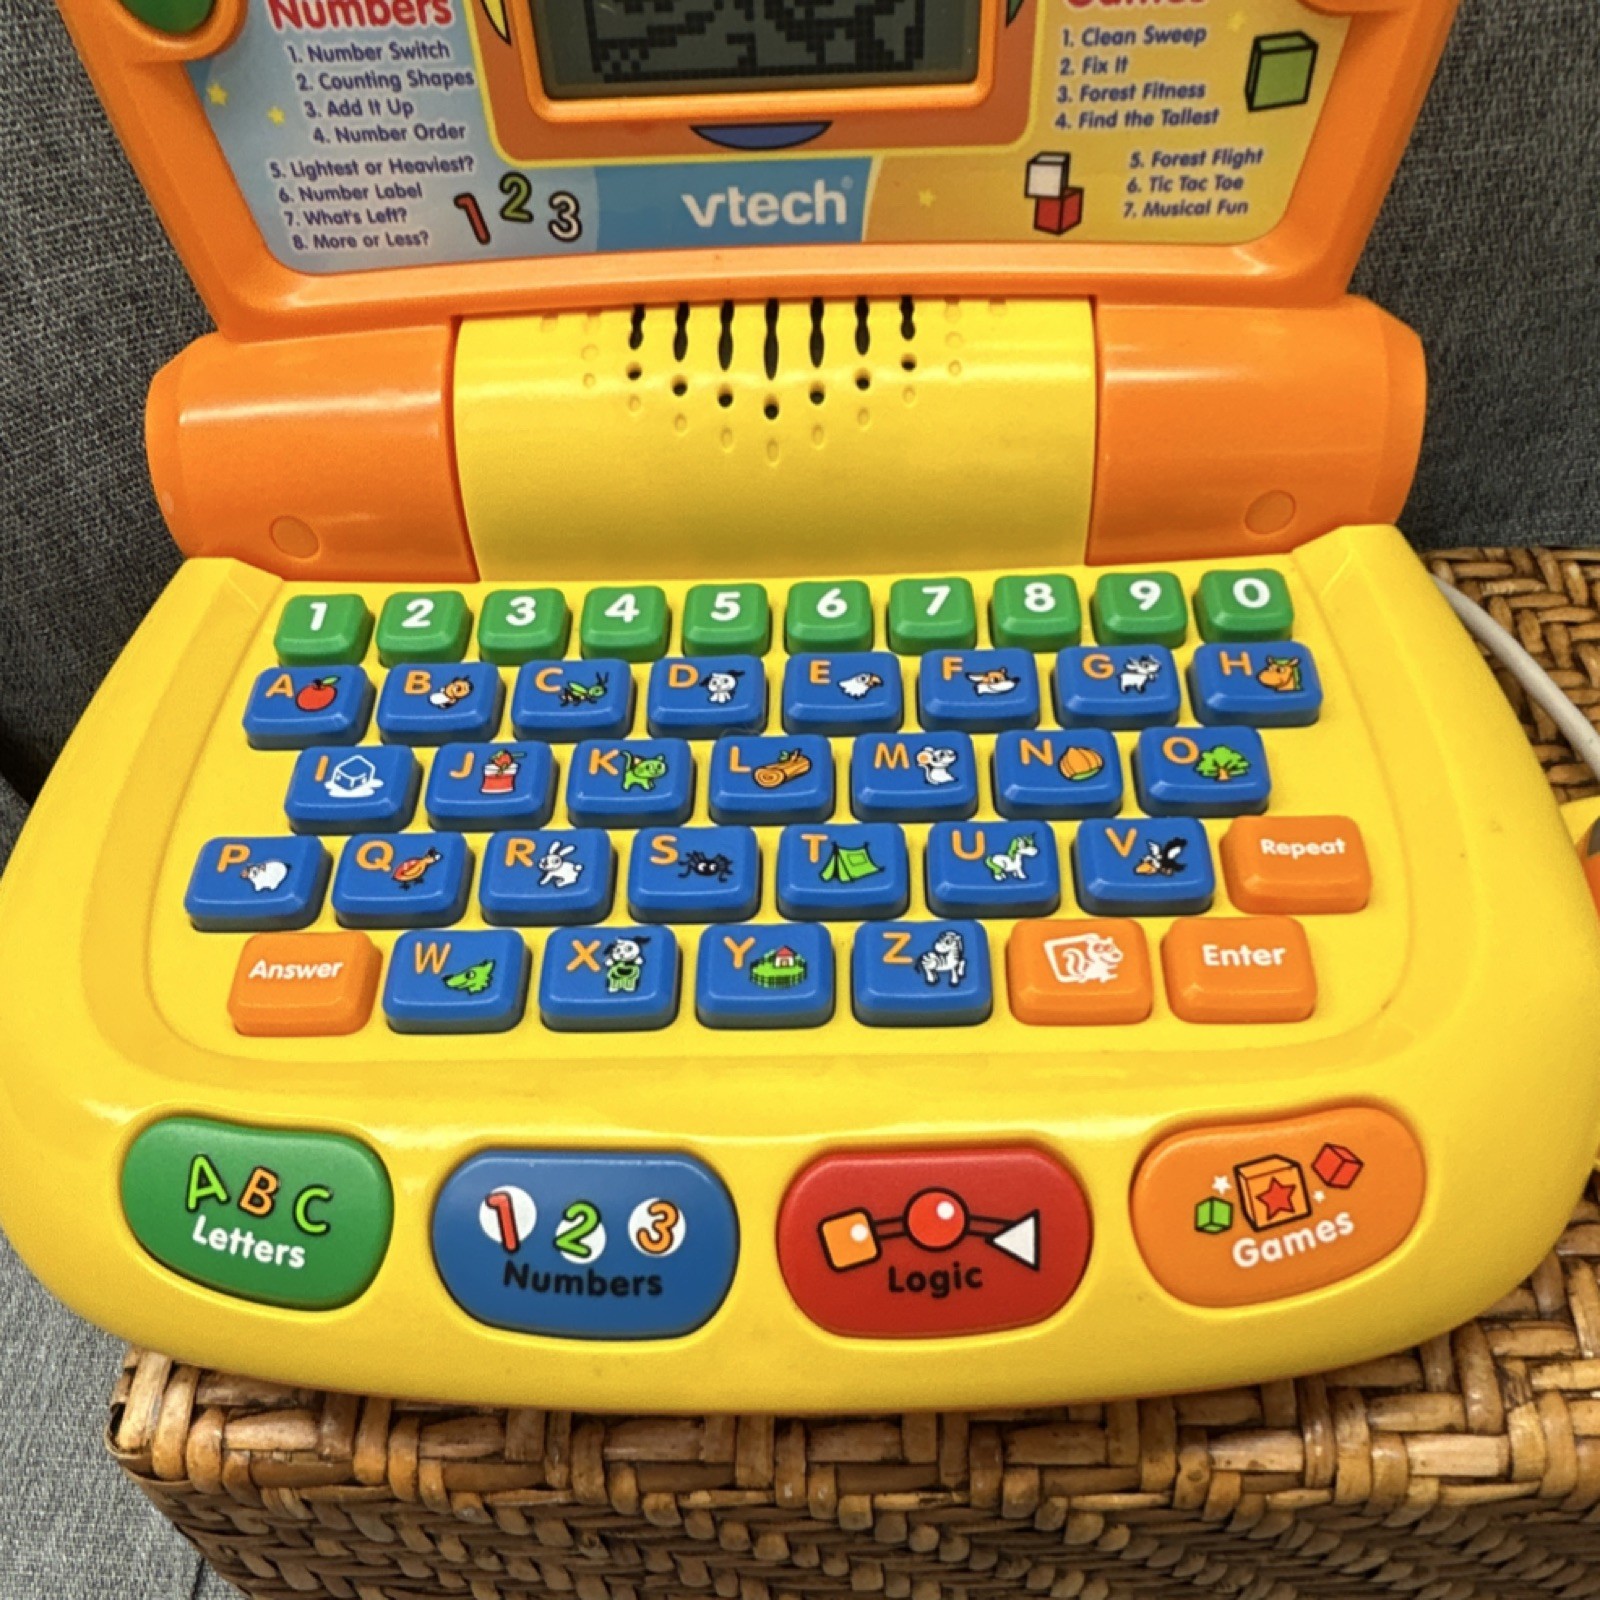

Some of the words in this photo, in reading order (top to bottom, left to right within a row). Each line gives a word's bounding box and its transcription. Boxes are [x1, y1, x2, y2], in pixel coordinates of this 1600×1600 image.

[268, 0, 453, 29] Numbers
[1063, 28, 1074, 47] 1.
[1082, 27, 1136, 47] Clean
[1144, 25, 1207, 46] Sweep
[288, 45, 302, 63] 1.
[307, 44, 383, 62] Number
[389, 41, 450, 59] Switch
[1060, 57, 1074, 76] 2.
[1082, 56, 1108, 74] Fix
[1115, 56, 1128, 73] It
[297, 74, 313, 91] 2.
[319, 71, 402, 92] Counting
[407, 69, 474, 91] Shapes
[1057, 86, 1072, 103] 3.
[1080, 84, 1136, 102] Forest
[1143, 82, 1206, 99] Fitness
[304, 101, 321, 118] 3.
[327, 99, 363, 117] Add
[369, 99, 381, 115] It
[388, 99, 414, 119] Up
[1056, 112, 1071, 129] 4.
[1079, 111, 1118, 129] Find
[1124, 109, 1154, 127] the
[1161, 108, 1219, 126] Tallest
[313, 128, 331, 143] 4.
[334, 125, 407, 143] Number
[414, 123, 465, 140] Order
[270, 162, 286, 178] 5.
[290, 160, 359, 180] Lightest
[365, 163, 383, 175] or
[389, 156, 474, 175] Heaviest?
[1130, 151, 1144, 168] 5.
[1152, 150, 1207, 167] Forest
[1212, 147, 1264, 169] Flight
[279, 188, 294, 203] 6.
[298, 185, 369, 202] Number
[375, 182, 422, 199] Label
[1127, 177, 1141, 193] 6.
[1150, 175, 1173, 192] Tic
[1179, 175, 1207, 191] Tac
[1215, 174, 1244, 190] Toe
[284, 211, 300, 226] 7.
[303, 208, 362, 225] What's
[367, 207, 407, 223] Left?
[454, 193, 490, 245] 1
[500, 172, 534, 223] 2
[549, 191, 582, 242] 3
[1124, 202, 1136, 218] 7.
[1143, 200, 1211, 217] Musical
[1217, 200, 1248, 214] Fun
[293, 235, 308, 249] 8.
[313, 233, 357, 248] More
[363, 235, 380, 247] or
[385, 231, 429, 247] Less?
[817, 588, 848, 617] 6
[922, 586, 951, 615] 7
[1024, 582, 1055, 612] 8
[1129, 580, 1161, 610] 9
[1233, 577, 1271, 607] 0
[309, 602, 327, 630] 1
[401, 599, 434, 629] 2
[506, 597, 536, 626] 3
[604, 594, 639, 623] 4
[711, 592, 741, 620] 5
[669, 664, 698, 688] D
[810, 660, 831, 684] E
[943, 657, 962, 681] F
[1082, 654, 1114, 679] G
[1219, 652, 1252, 676] H
[265, 674, 294, 698] A
[404, 672, 431, 695] B
[535, 668, 563, 692] C
[589, 748, 620, 774] K
[730, 747, 751, 772] L
[874, 744, 909, 769] M
[1021, 740, 1053, 765] N
[1163, 737, 1197, 763] O
[314, 756, 330, 782] I
[450, 752, 475, 777] J
[505, 838, 533, 867] R
[650, 837, 678, 864] S
[801, 834, 829, 863] T
[953, 831, 985, 860] U
[1105, 828, 1137, 857] V
[1261, 838, 1346, 859] Repeat
[217, 844, 251, 872] P
[356, 841, 394, 871] Q
[413, 942, 452, 973] W
[566, 941, 602, 971] X
[724, 937, 755, 968] Y
[882, 933, 913, 963] Z
[1203, 943, 1287, 968] Enter
[248, 958, 343, 980] Answer
[186, 1154, 228, 1212] A
[238, 1166, 279, 1216] B
[293, 1185, 332, 1235] C
[483, 1190, 521, 1252] 1
[553, 1199, 601, 1257] 2
[636, 1200, 679, 1254] 3
[192, 1215, 306, 1268] Letters
[1232, 1210, 1354, 1269] Games
[503, 1260, 663, 1296] Numbers
[889, 1264, 982, 1298] Logic
